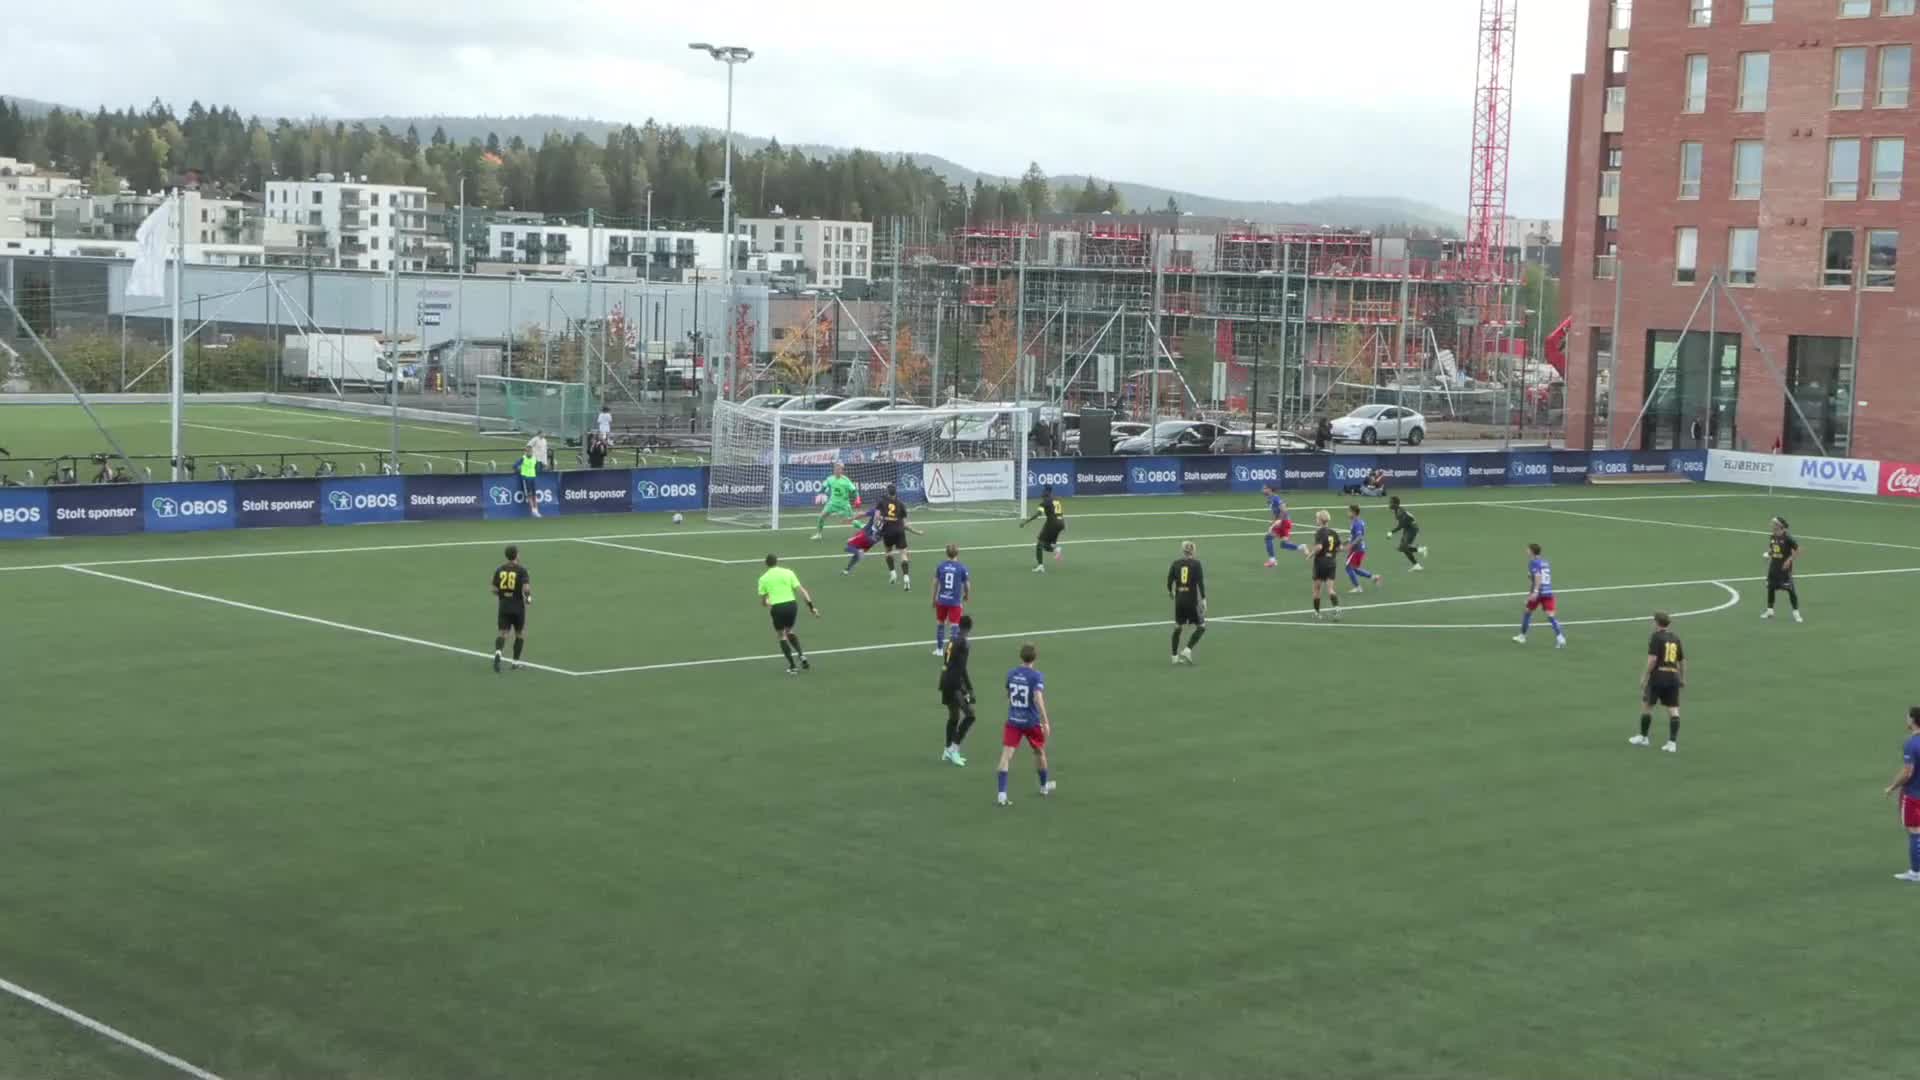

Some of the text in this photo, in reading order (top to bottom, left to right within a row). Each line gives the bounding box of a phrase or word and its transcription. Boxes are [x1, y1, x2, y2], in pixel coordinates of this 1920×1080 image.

[1438, 466, 1462, 477] OBOS
[1525, 464, 1547, 474] OBOS
[1605, 463, 1627, 473] OBOS
[1683, 462, 1704, 472] OBOS
[1800, 459, 1867, 482] MOVA
[1038, 473, 1068, 485] OBOS
[1076, 474, 1124, 483] Stolt sponsor
[1147, 471, 1176, 482] OBOS
[1184, 472, 1227, 481] Stolt sponsor
[1250, 469, 1277, 480] OBOS
[1284, 470, 1326, 479] Stolt sponsor
[660, 484, 696, 497] OBOS
[795, 480, 823, 493] OBO
[410, 495, 477, 506] Stolt sponsor
[513, 489, 553, 503] OOS
[564, 489, 626, 500] Stolt sponsor
[180, 500, 228, 515] OBOS
[242, 500, 315, 512] Stolt sponsor
[354, 494, 398, 509] OBOS
[0, 507, 40, 522] BOS
[56, 508, 137, 520] Stolt sponsor
[887, 503, 897, 518] 2
[500, 571, 517, 590] 28
[945, 572, 955, 589] 9
[1181, 566, 1189, 584] 8
[1009, 683, 1029, 708] 23
